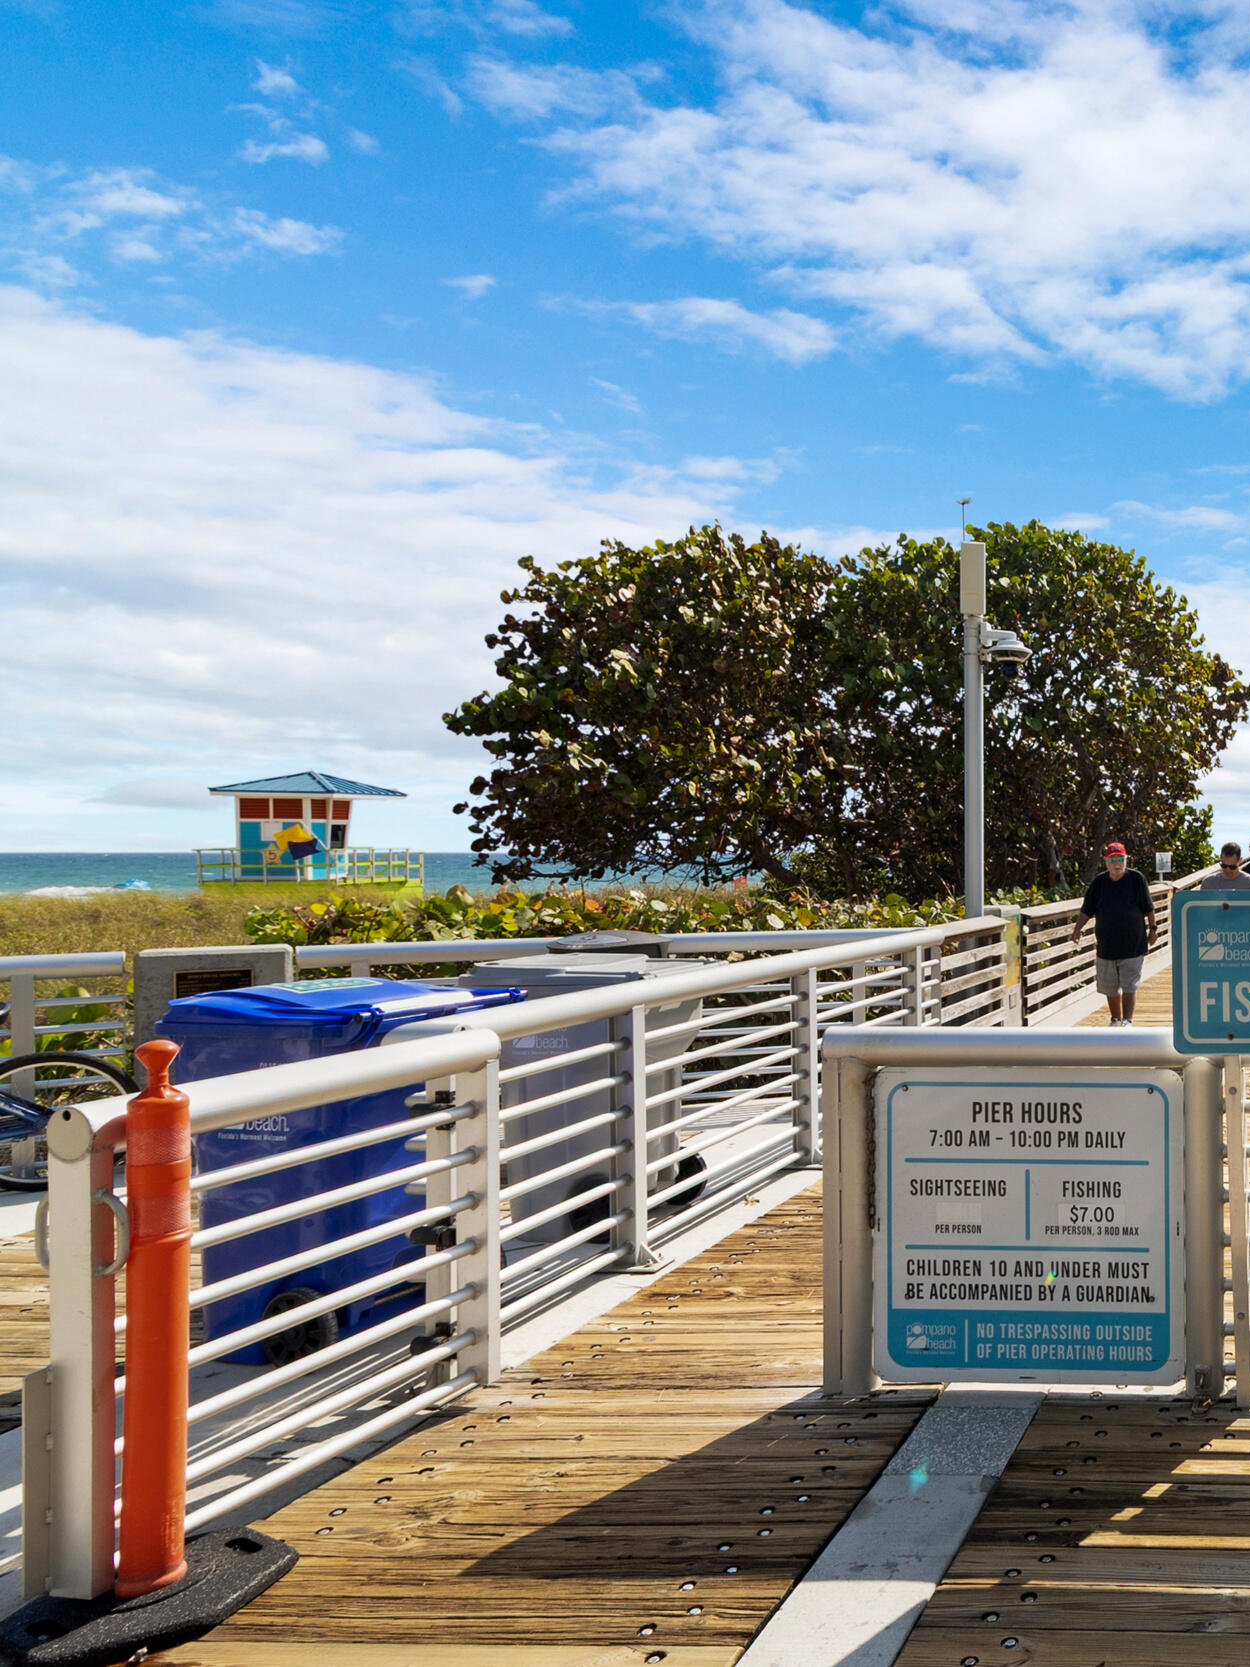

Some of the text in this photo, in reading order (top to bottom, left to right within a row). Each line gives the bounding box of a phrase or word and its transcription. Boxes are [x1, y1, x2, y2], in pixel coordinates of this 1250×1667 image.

[972, 1102, 1083, 1124] PIER HOURS
[929, 1130, 963, 1147] 7:00
[969, 1130, 991, 1148] AM
[1010, 1131, 1052, 1148] 10:00
[1058, 1131, 1080, 1149] PM
[1085, 1132, 1126, 1149] DAILY
[910, 1179, 1007, 1198] SIGHTSEEING
[1062, 1181, 1122, 1199] FISHING
[1070, 1206, 1115, 1224] $7.00
[935, 1224, 982, 1234] PER PERSON
[1045, 1225, 1140, 1236] PER PERSON, 3 ROD MAX
[906, 1260, 1150, 1279] CHILDREN 10 AND UNDER MUST
[907, 1283, 924, 1300] BE
[929, 1283, 1033, 1301] ACCOMPANIED
[1038, 1285, 1056, 1301] BY
[1061, 1285, 1071, 1302] A
[976, 1323, 1153, 1342] NO TRESPASSING OUTSIDE
[976, 1343, 1153, 1362] OF PIER OPERATING HOURS
